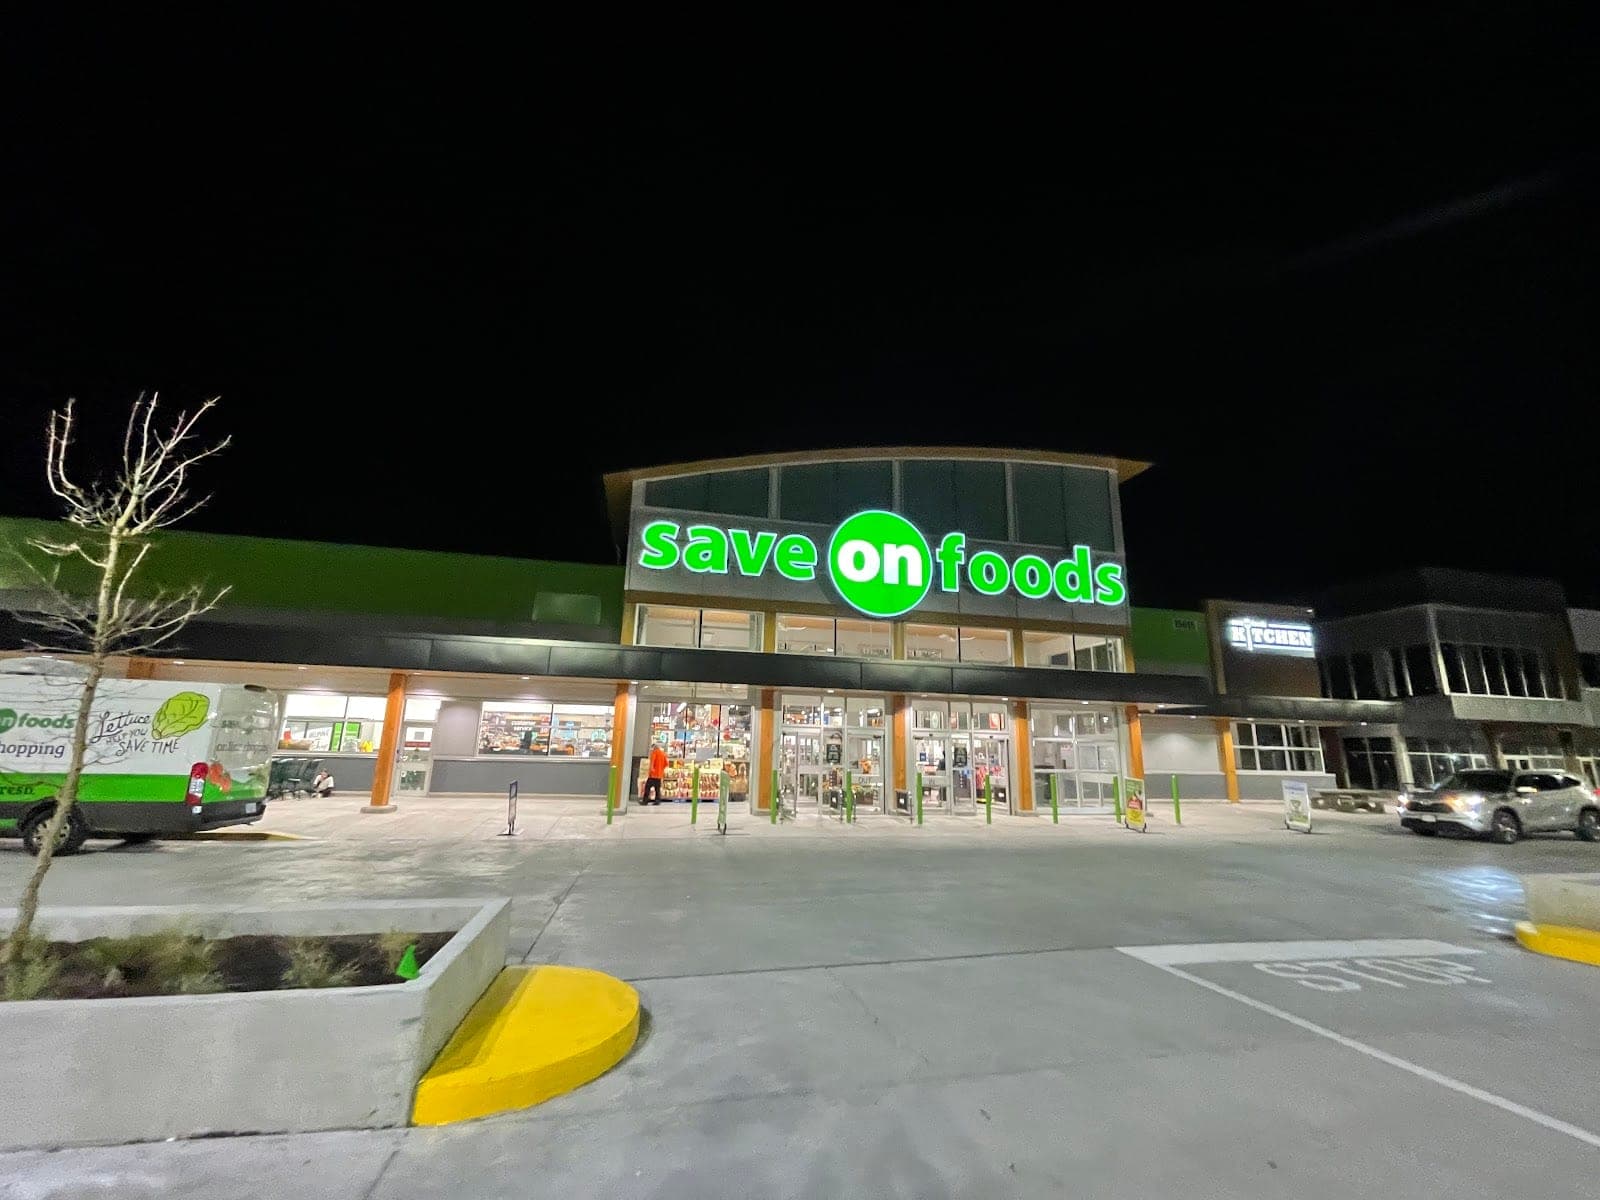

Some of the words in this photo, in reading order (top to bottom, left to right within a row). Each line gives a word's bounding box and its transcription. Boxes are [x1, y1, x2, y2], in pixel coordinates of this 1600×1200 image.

[639, 520, 818, 582] save
[836, 539, 924, 588] on
[935, 532, 1126, 606] foods
[1231, 624, 1313, 649] KITCHEN
[18, 713, 75, 729] foods
[89, 711, 150, 744] Lettuce
[130, 728, 149, 738] YOU
[115, 739, 150, 757] SAVE
[152, 739, 180, 755] TIME
[1252, 958, 1493, 992] STOP
